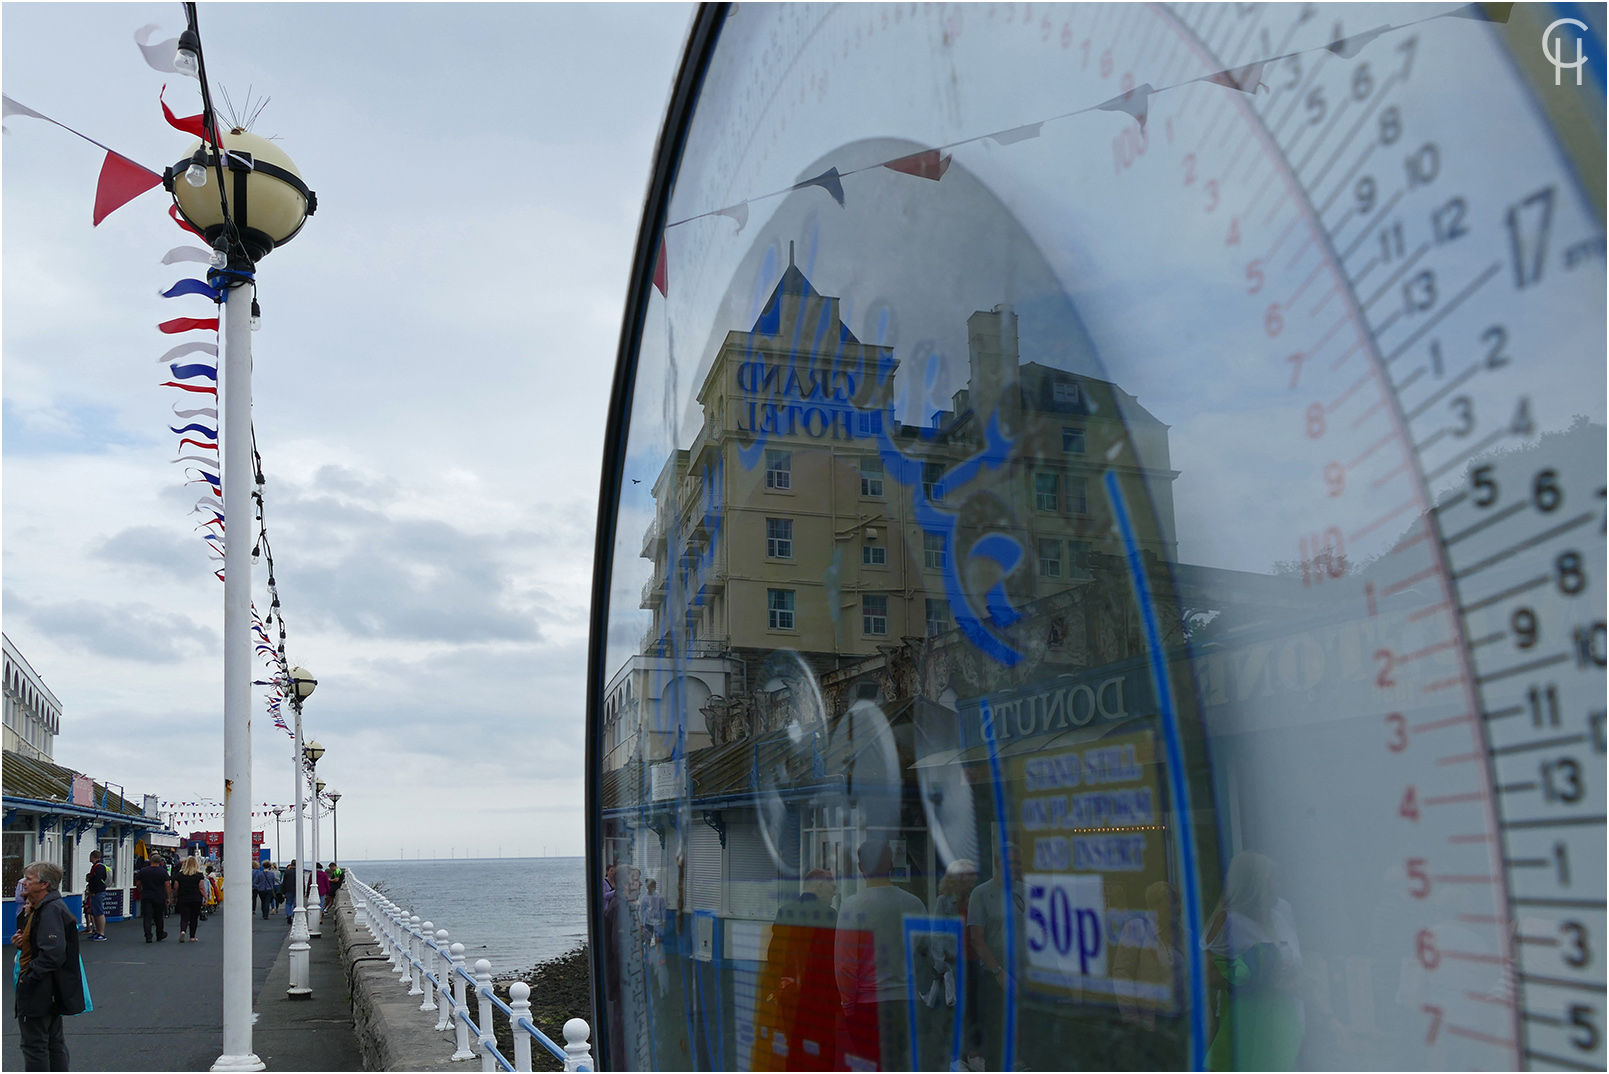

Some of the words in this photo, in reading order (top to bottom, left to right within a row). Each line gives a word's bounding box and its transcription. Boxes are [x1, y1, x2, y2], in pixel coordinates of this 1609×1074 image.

[1397, 33, 1419, 81] 7
[1351, 62, 1373, 104] 6
[1306, 85, 1327, 126] 5
[1378, 105, 1402, 146] 8
[1182, 153, 1197, 186] 2
[1405, 142, 1441, 190] 10
[1203, 179, 1220, 212] 3
[1354, 175, 1377, 215] 9
[1432, 196, 1471, 244] 12
[1505, 184, 1558, 290] 17
[1380, 220, 1404, 265] 11
[1246, 258, 1264, 295] 5
[1402, 269, 1437, 316] 13
[1264, 302, 1284, 339] 6
[1430, 338, 1445, 379] 1
[1480, 324, 1512, 373] 2
[1287, 352, 1306, 391] 7
[1305, 401, 1327, 440] 8
[1450, 394, 1477, 439] 3
[1508, 393, 1538, 437] 4
[1323, 460, 1346, 498] 9
[1471, 464, 1498, 508] 5
[1533, 468, 1563, 513] 6
[1555, 548, 1587, 596] 8
[1364, 580, 1378, 617] 1
[1511, 606, 1539, 650] 9
[1373, 647, 1396, 689] 2
[1527, 684, 1562, 727] 11
[1384, 712, 1410, 753] 3
[1541, 757, 1585, 804] 13
[1399, 783, 1421, 824] 4
[1405, 857, 1432, 899] 5
[1554, 842, 1571, 888] 1
[1028, 885, 1101, 975] 50p
[1414, 927, 1441, 972] 6
[1560, 920, 1592, 970] 3
[1421, 1002, 1444, 1046] 7
[1569, 1003, 1602, 1054] 5
